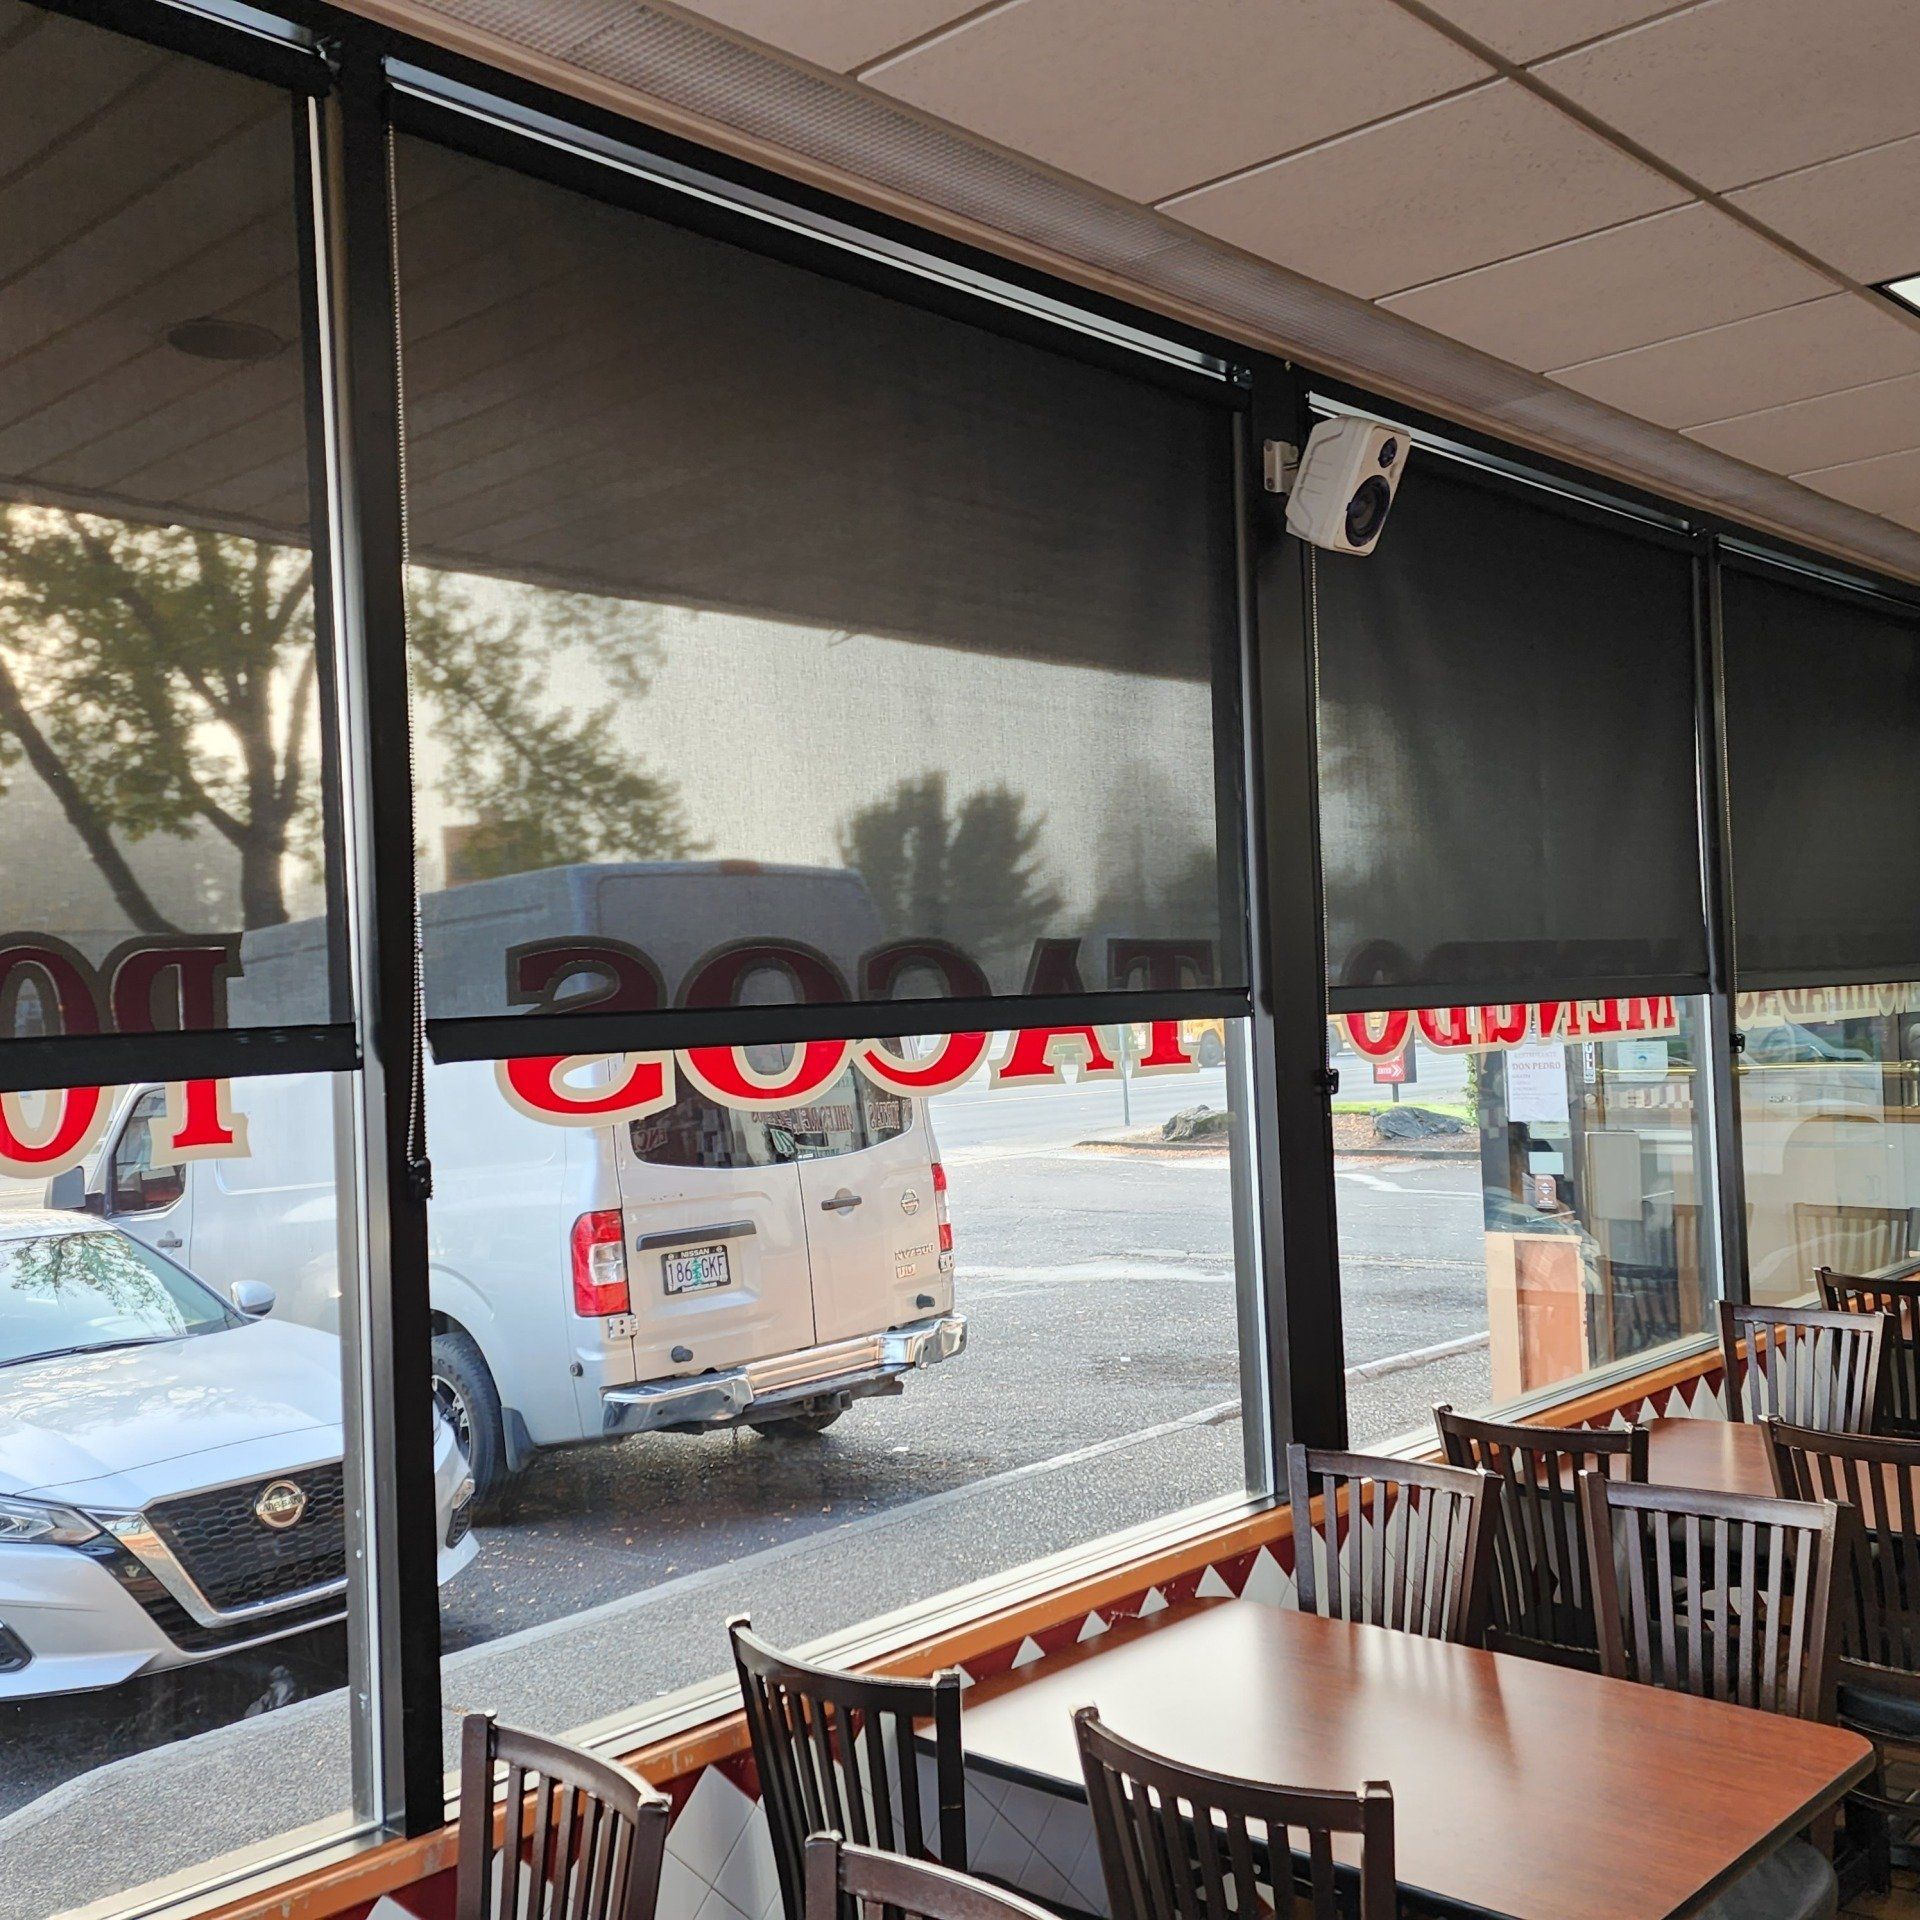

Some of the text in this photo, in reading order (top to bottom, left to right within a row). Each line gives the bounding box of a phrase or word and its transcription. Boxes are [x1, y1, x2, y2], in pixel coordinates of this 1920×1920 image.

[1512, 1061, 1561, 1070] DON PEDRO
[680, 1248, 710, 1258] NISSAN
[668, 1261, 693, 1290] 186
[701, 1255, 725, 1279] GKF
[262, 1493, 302, 1512] NISSAN
